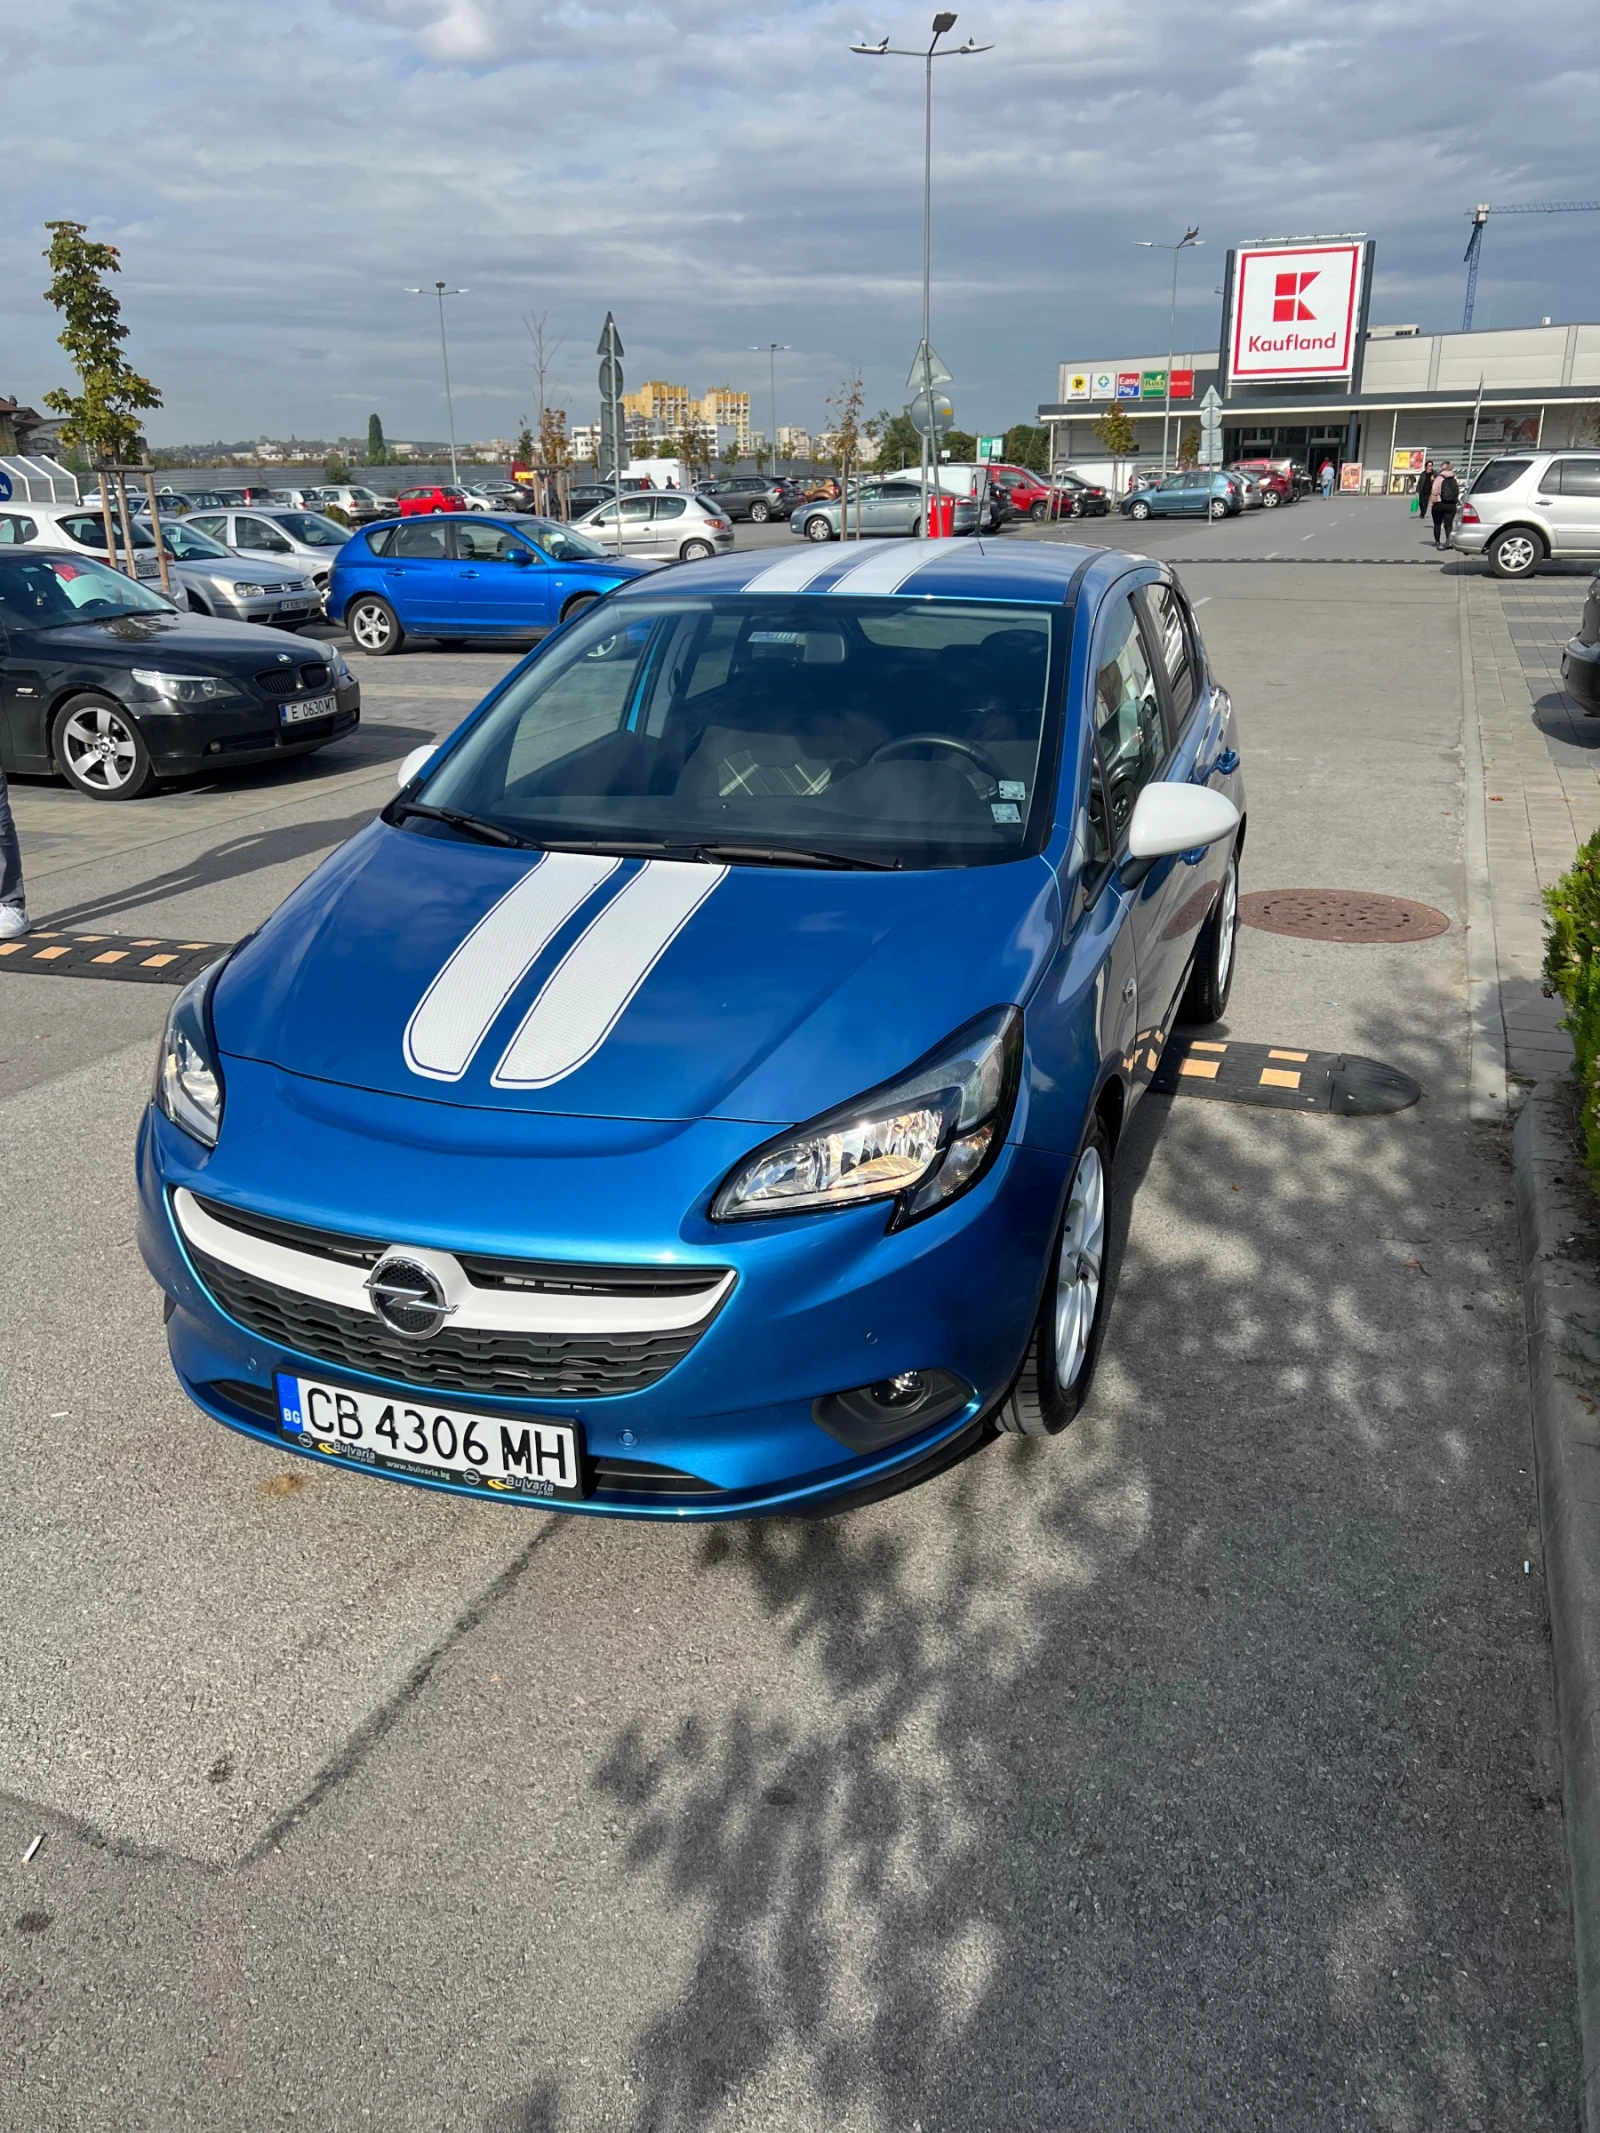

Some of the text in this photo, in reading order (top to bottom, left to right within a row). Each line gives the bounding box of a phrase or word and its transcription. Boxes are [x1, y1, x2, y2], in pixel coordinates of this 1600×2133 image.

[1248, 332, 1336, 352] Kaufland
[1119, 377, 1139, 386] Easy
[1118, 386, 1135, 396] Pay
[291, 705, 299, 720] E
[283, 1387, 567, 1480] BG CB 4306 MH
[334, 1441, 376, 1460] Bulvaria
[386, 1460, 451, 1480] www.bulvaria.bg
[506, 1476, 555, 1492] Bulvaria
